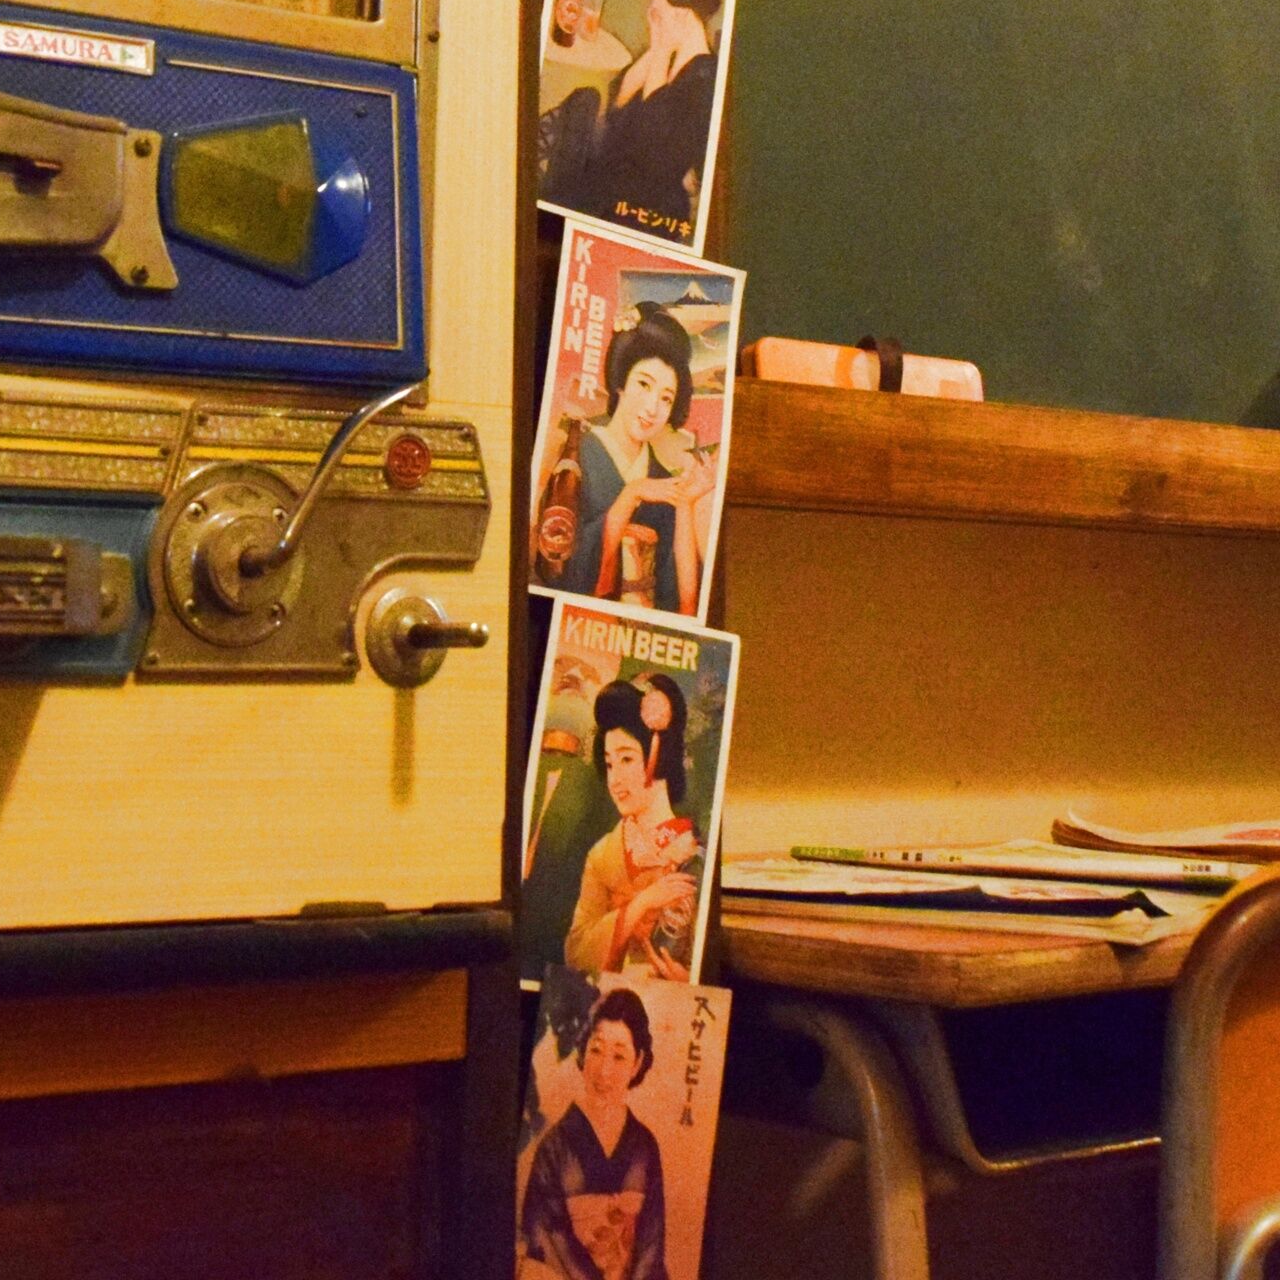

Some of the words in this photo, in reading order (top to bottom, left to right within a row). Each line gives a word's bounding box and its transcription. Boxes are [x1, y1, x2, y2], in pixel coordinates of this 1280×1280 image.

[564, 236, 594, 355] KIRIN
[578, 293, 609, 401] BEER
[563, 614, 632, 659] KIRIN
[634, 630, 700, 672] BEER
